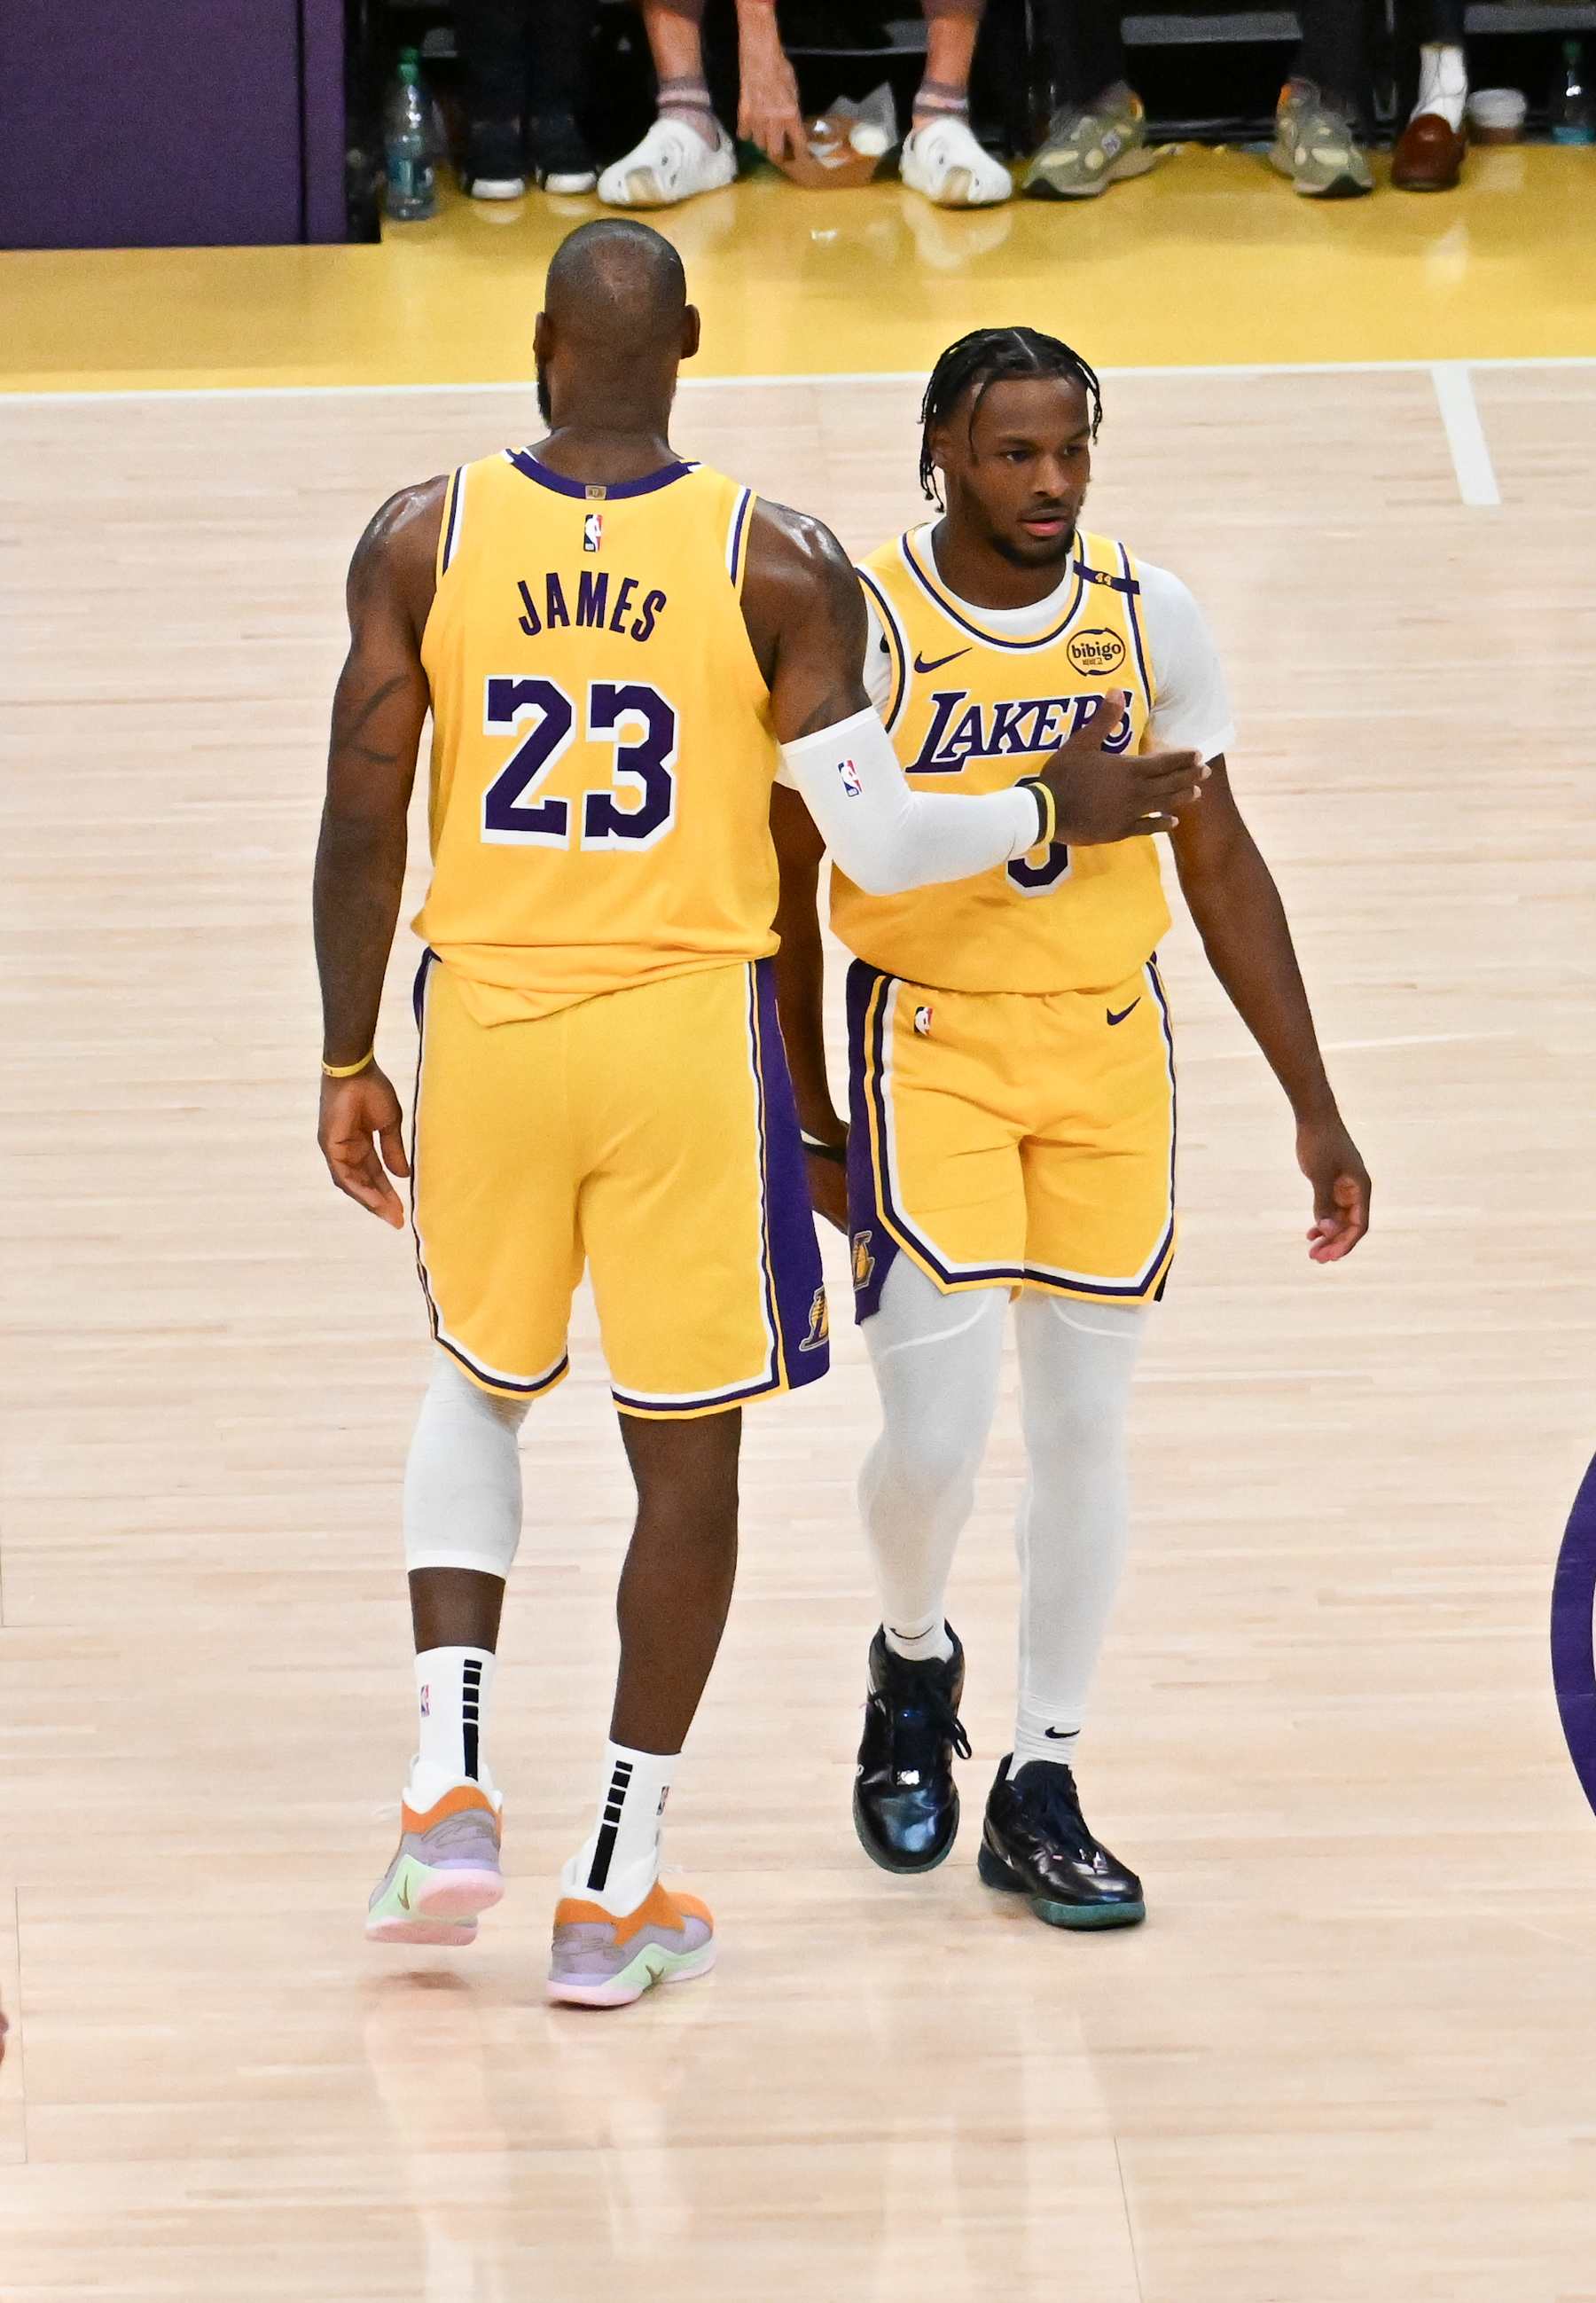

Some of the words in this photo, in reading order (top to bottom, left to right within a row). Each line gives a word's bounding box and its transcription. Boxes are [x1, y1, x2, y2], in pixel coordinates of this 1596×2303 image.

[518, 570, 666, 642] JAMES
[1071, 641, 1122, 661] bibigo
[483, 676, 677, 844] 23
